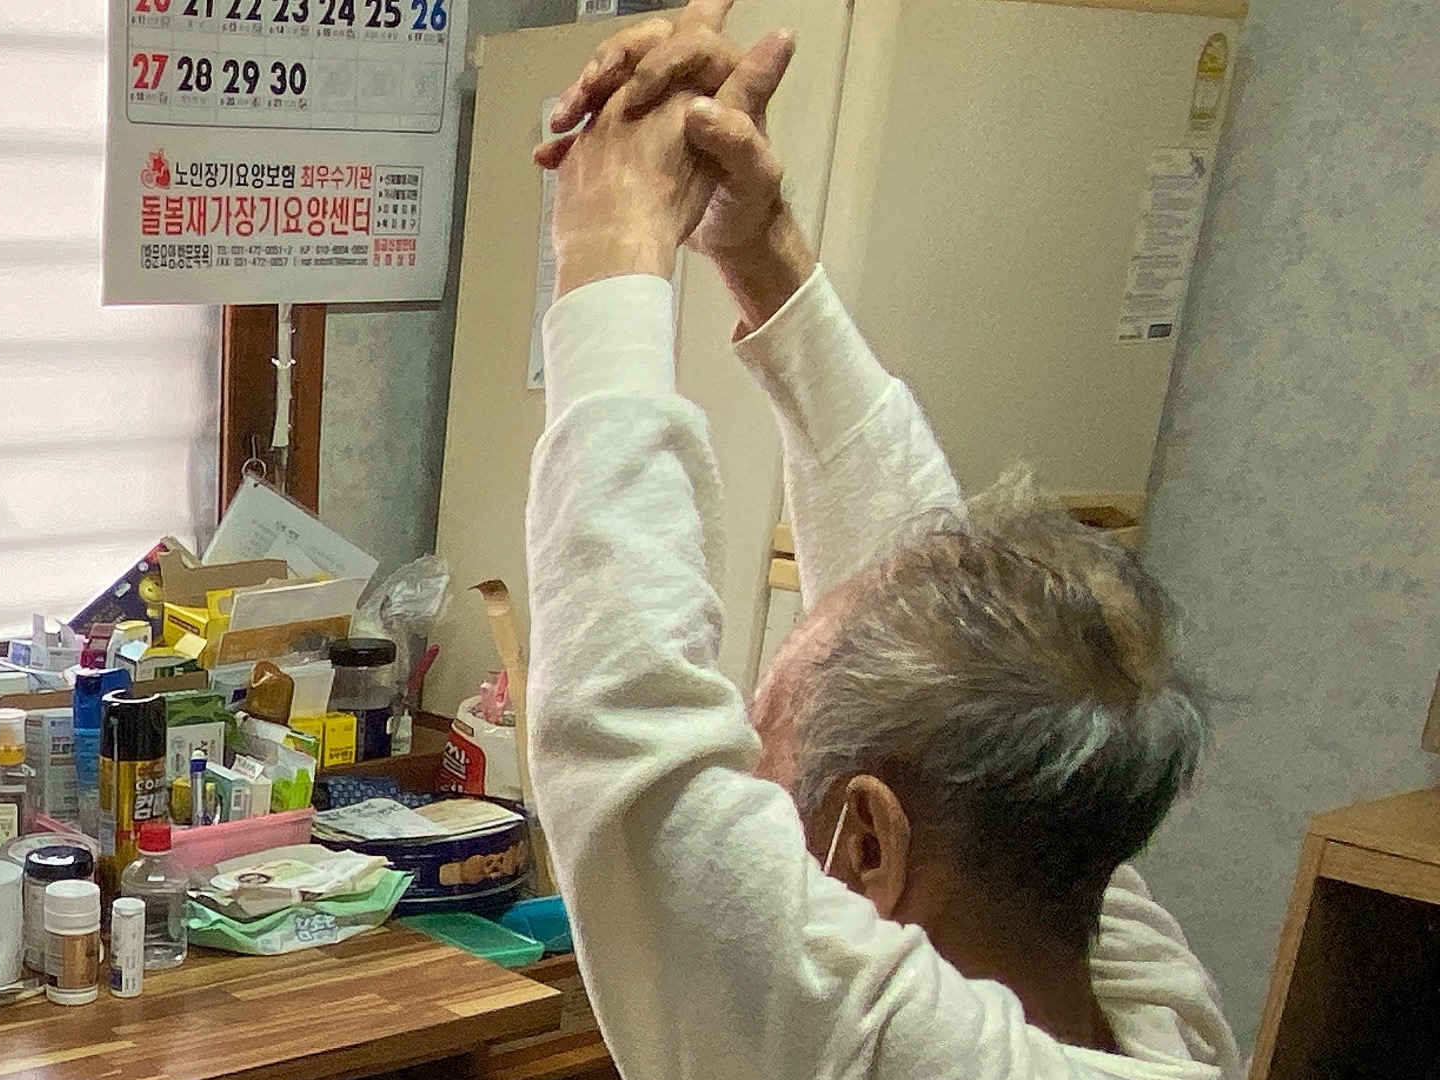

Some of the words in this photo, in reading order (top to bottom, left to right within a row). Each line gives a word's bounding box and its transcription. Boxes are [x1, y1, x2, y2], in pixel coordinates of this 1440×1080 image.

[272, 0, 309, 23] 23
[319, 0, 355, 26] 24
[365, 0, 402, 28] 25
[411, 0, 447, 31] 26
[132, 53, 169, 90] 27
[177, 56, 212, 92] 28
[222, 59, 260, 94] 29
[270, 61, 306, 95] 30
[174, 162, 296, 189] 노인장기요양보험
[300, 165, 372, 190] 최우수기관
[141, 195, 371, 237] 돌봄재가장기요양센터
